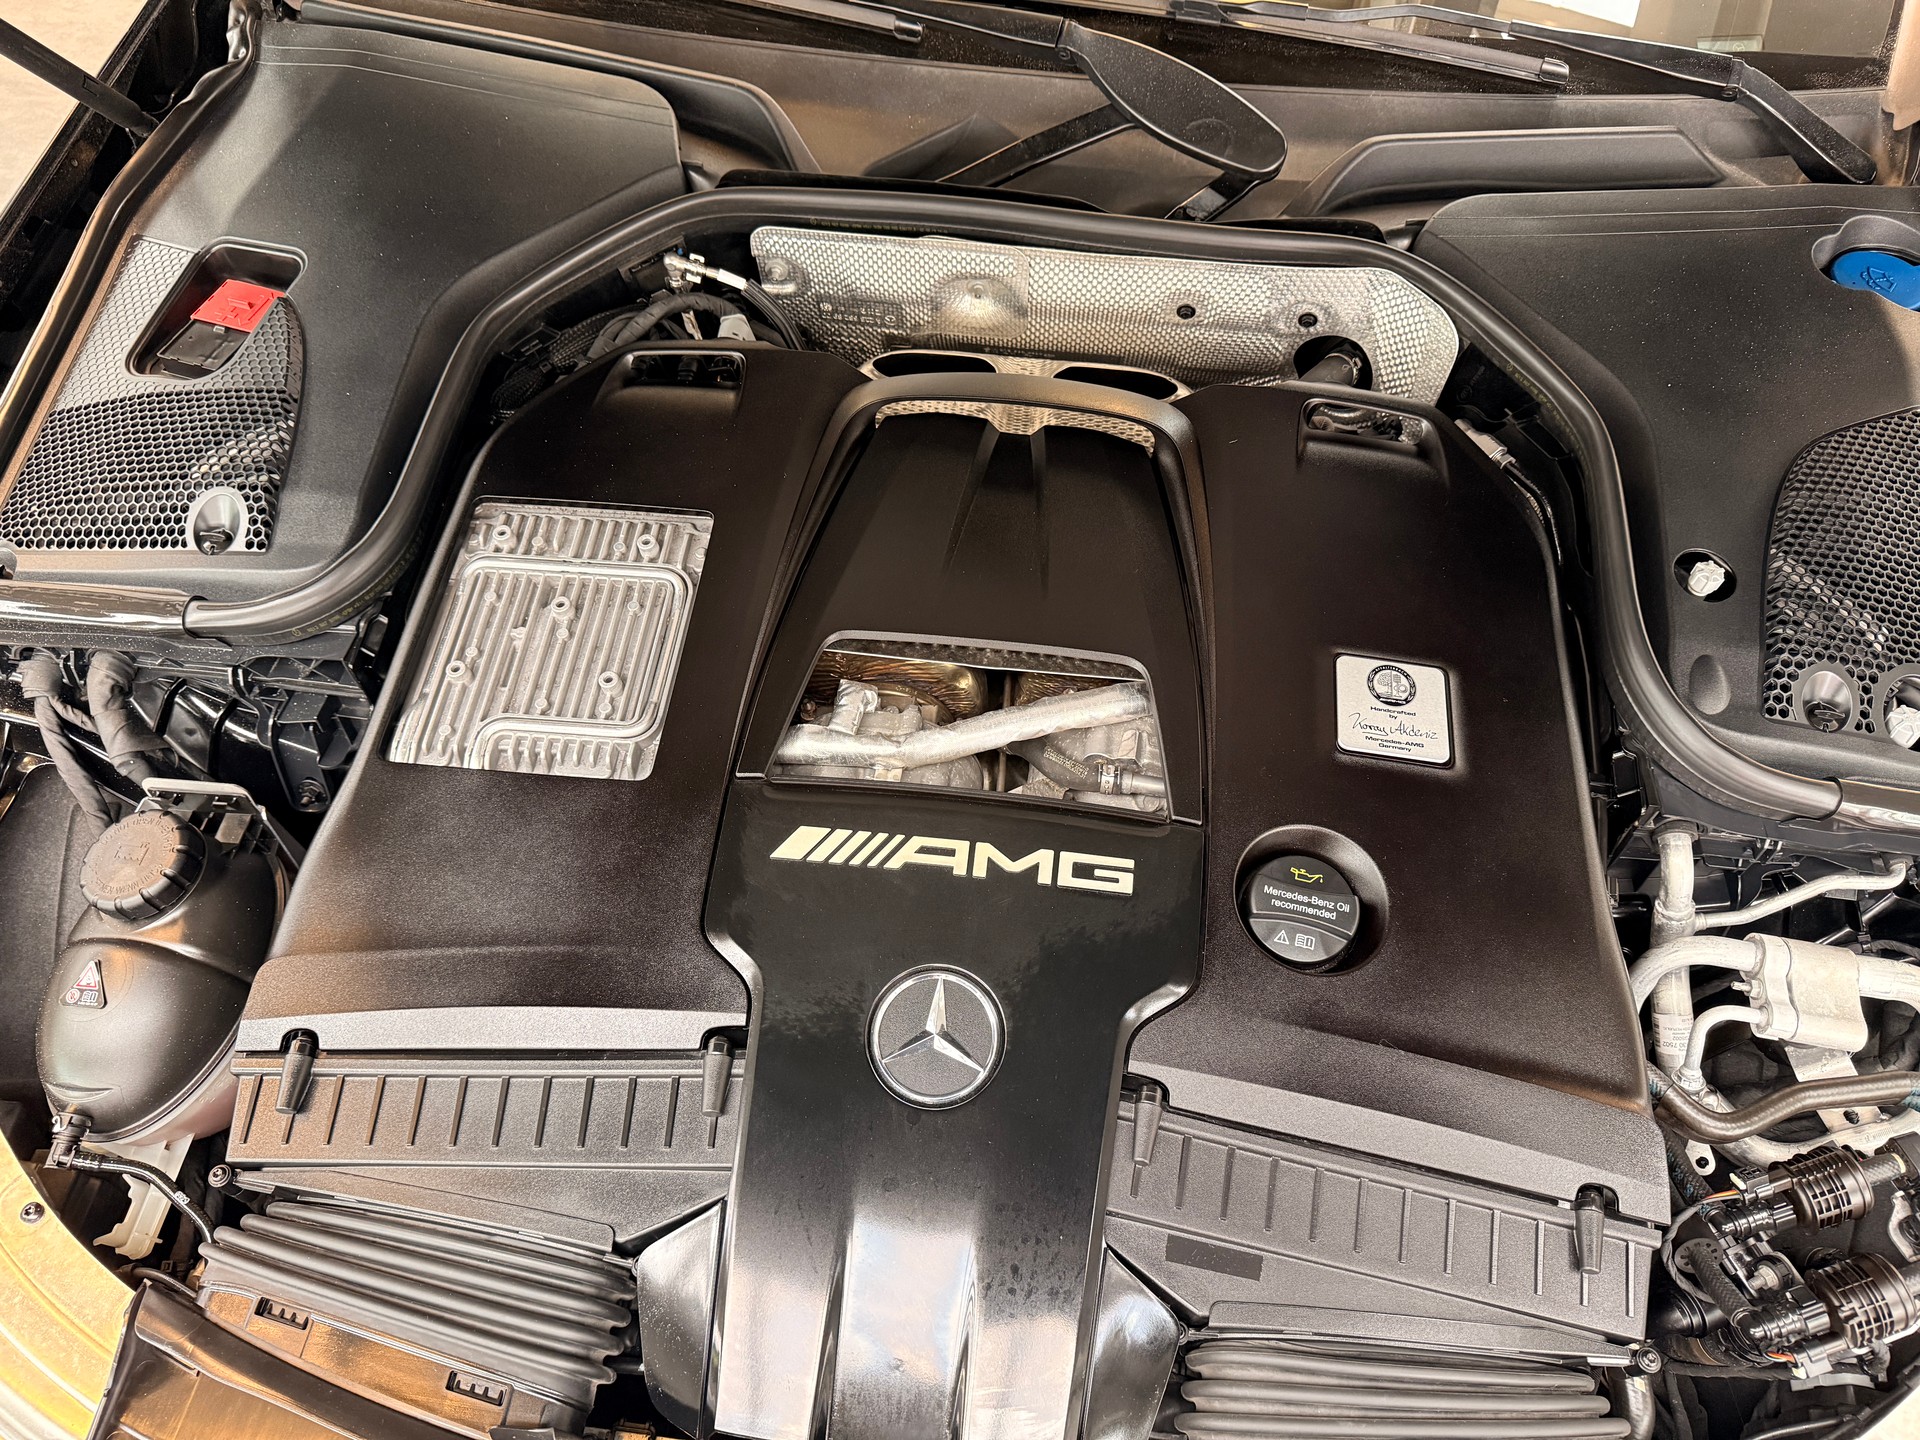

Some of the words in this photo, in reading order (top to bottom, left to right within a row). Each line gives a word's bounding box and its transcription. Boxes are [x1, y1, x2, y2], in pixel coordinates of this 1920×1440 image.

[1370, 706, 1417, 717] Handcrafted
[1389, 720, 1439, 740] Akdeniz
[1365, 735, 1425, 748] Mercedes-AMG
[1379, 742, 1412, 753] Germany
[882, 835, 1135, 896] AMG
[1263, 884, 1335, 909] Mercedes-Benz
[1337, 902, 1350, 913] Oil
[1271, 898, 1337, 920] recommended
